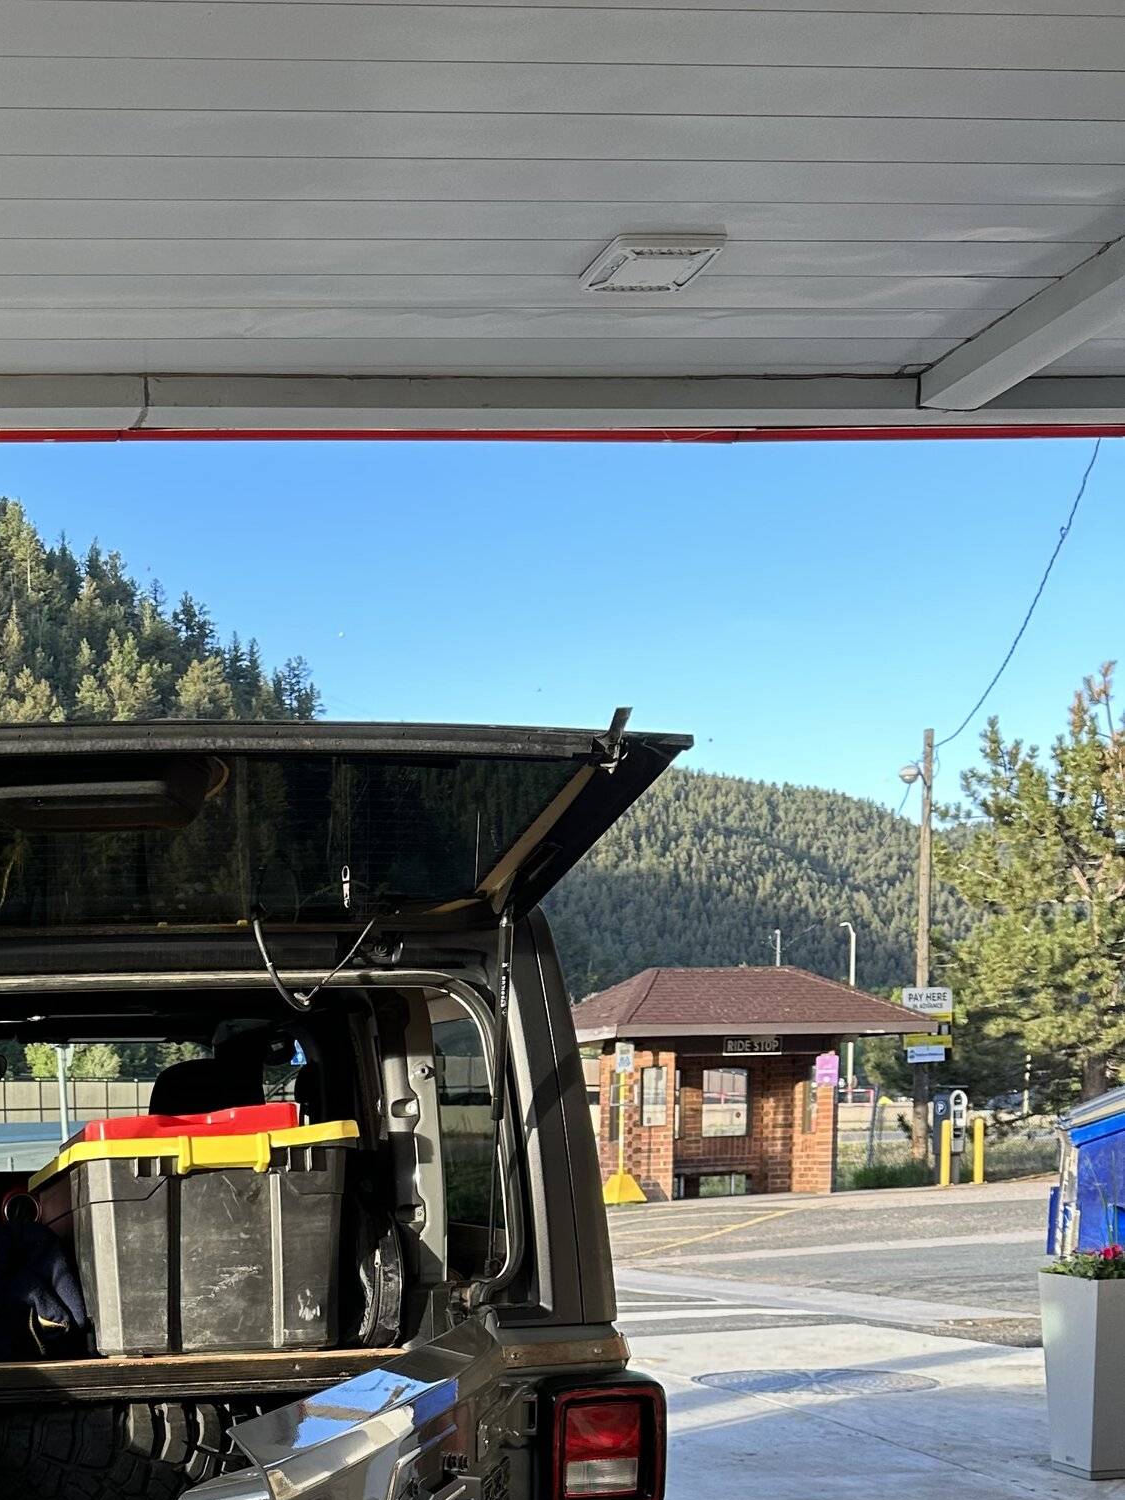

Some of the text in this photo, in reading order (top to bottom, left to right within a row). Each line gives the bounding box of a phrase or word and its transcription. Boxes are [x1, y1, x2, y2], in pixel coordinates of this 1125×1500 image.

[908, 992, 948, 1002] PAY HERE
[726, 1040, 779, 1052] RIDE STOP
